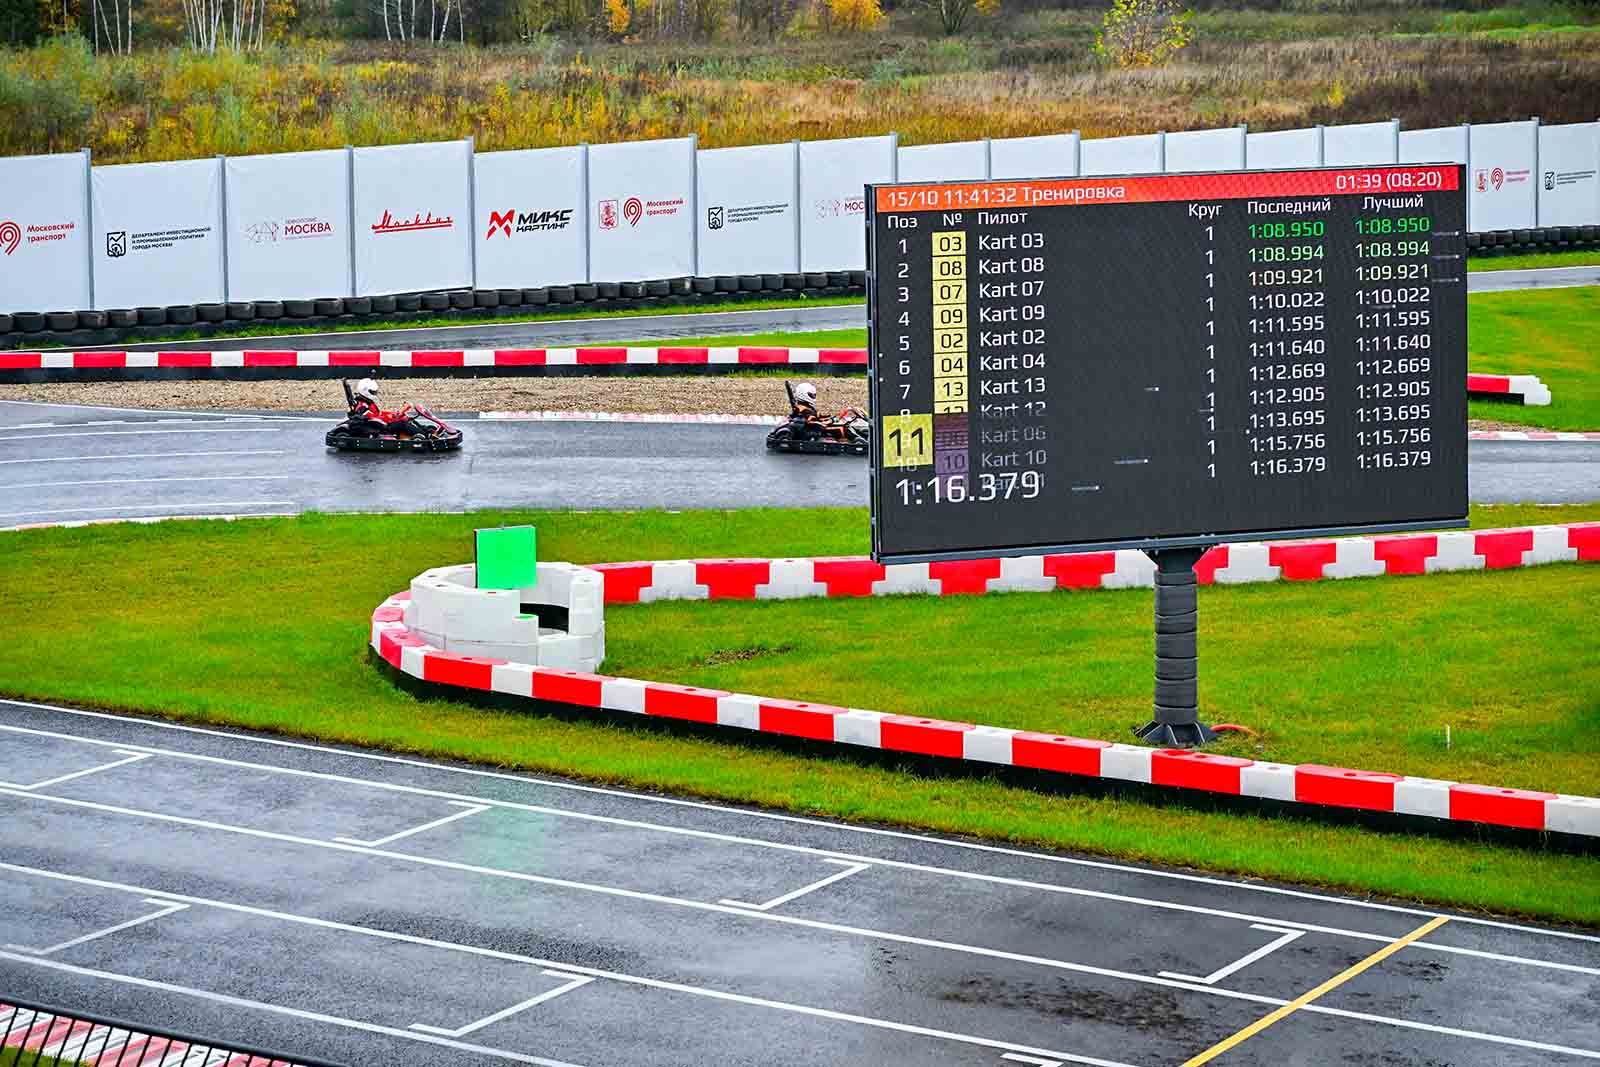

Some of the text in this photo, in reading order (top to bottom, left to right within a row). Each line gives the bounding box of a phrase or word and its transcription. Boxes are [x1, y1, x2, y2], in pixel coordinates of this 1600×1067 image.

[888, 185, 1126, 206] 15/10 11:41:32 Тренировка
[1336, 171, 1442, 190] 01:39 (08:20)
[26, 221, 75, 233] Московский
[284, 222, 332, 235] МОСКВА
[516, 222, 570, 233] КАРТИНГ
[517, 209, 574, 225] МИКС
[887, 194, 1424, 229] Поз № Пилот Круг Последний Лучший
[27, 232, 67, 244] транспорт
[898, 217, 1430, 254] 1 03 Kart 03 1 1:08.950 1:08.950
[898, 240, 1430, 278] 2 08 Kart 08 1 1:08.994 1:08.994
[898, 264, 1430, 302] 3 07 Kart 07 1 1:09.921 1:09.921
[898, 287, 1430, 327] 4 09 Kart 09 1 1:10.022 1:10.022
[899, 311, 1430, 351] 5 02 Kart 02 1 1:11.595 1:11.595
[899, 334, 1430, 375] 6 04 Kart 04 1 1:11.640 1:11.640
[899, 357, 1431, 400] 7 13 Kart 13 1 1:12.669 1:12.669
[981, 403, 1020, 418] Kart
[1024, 401, 1047, 416] 12
[1206, 392, 1215, 407] 1
[1249, 386, 1326, 405] 1:12.905
[1356, 381, 1431, 399] 1:12.905
[981, 426, 1020, 443] Kart
[1207, 416, 1215, 431] 1
[1250, 410, 1326, 428] 1:13.695
[1356, 404, 1431, 422] 1:13.695
[888, 427, 924, 457] 11
[981, 451, 1020, 468] Kart
[1025, 450, 1047, 465] 10
[1207, 440, 1215, 455] 1
[1250, 433, 1326, 452] 1:15.756
[1356, 428, 1431, 446] 1:15.756
[1207, 464, 1216, 478] 1
[1250, 456, 1326, 476] 1:16.379
[1356, 451, 1431, 470] 1:16.379
[895, 470, 1040, 505] 1:16.379
